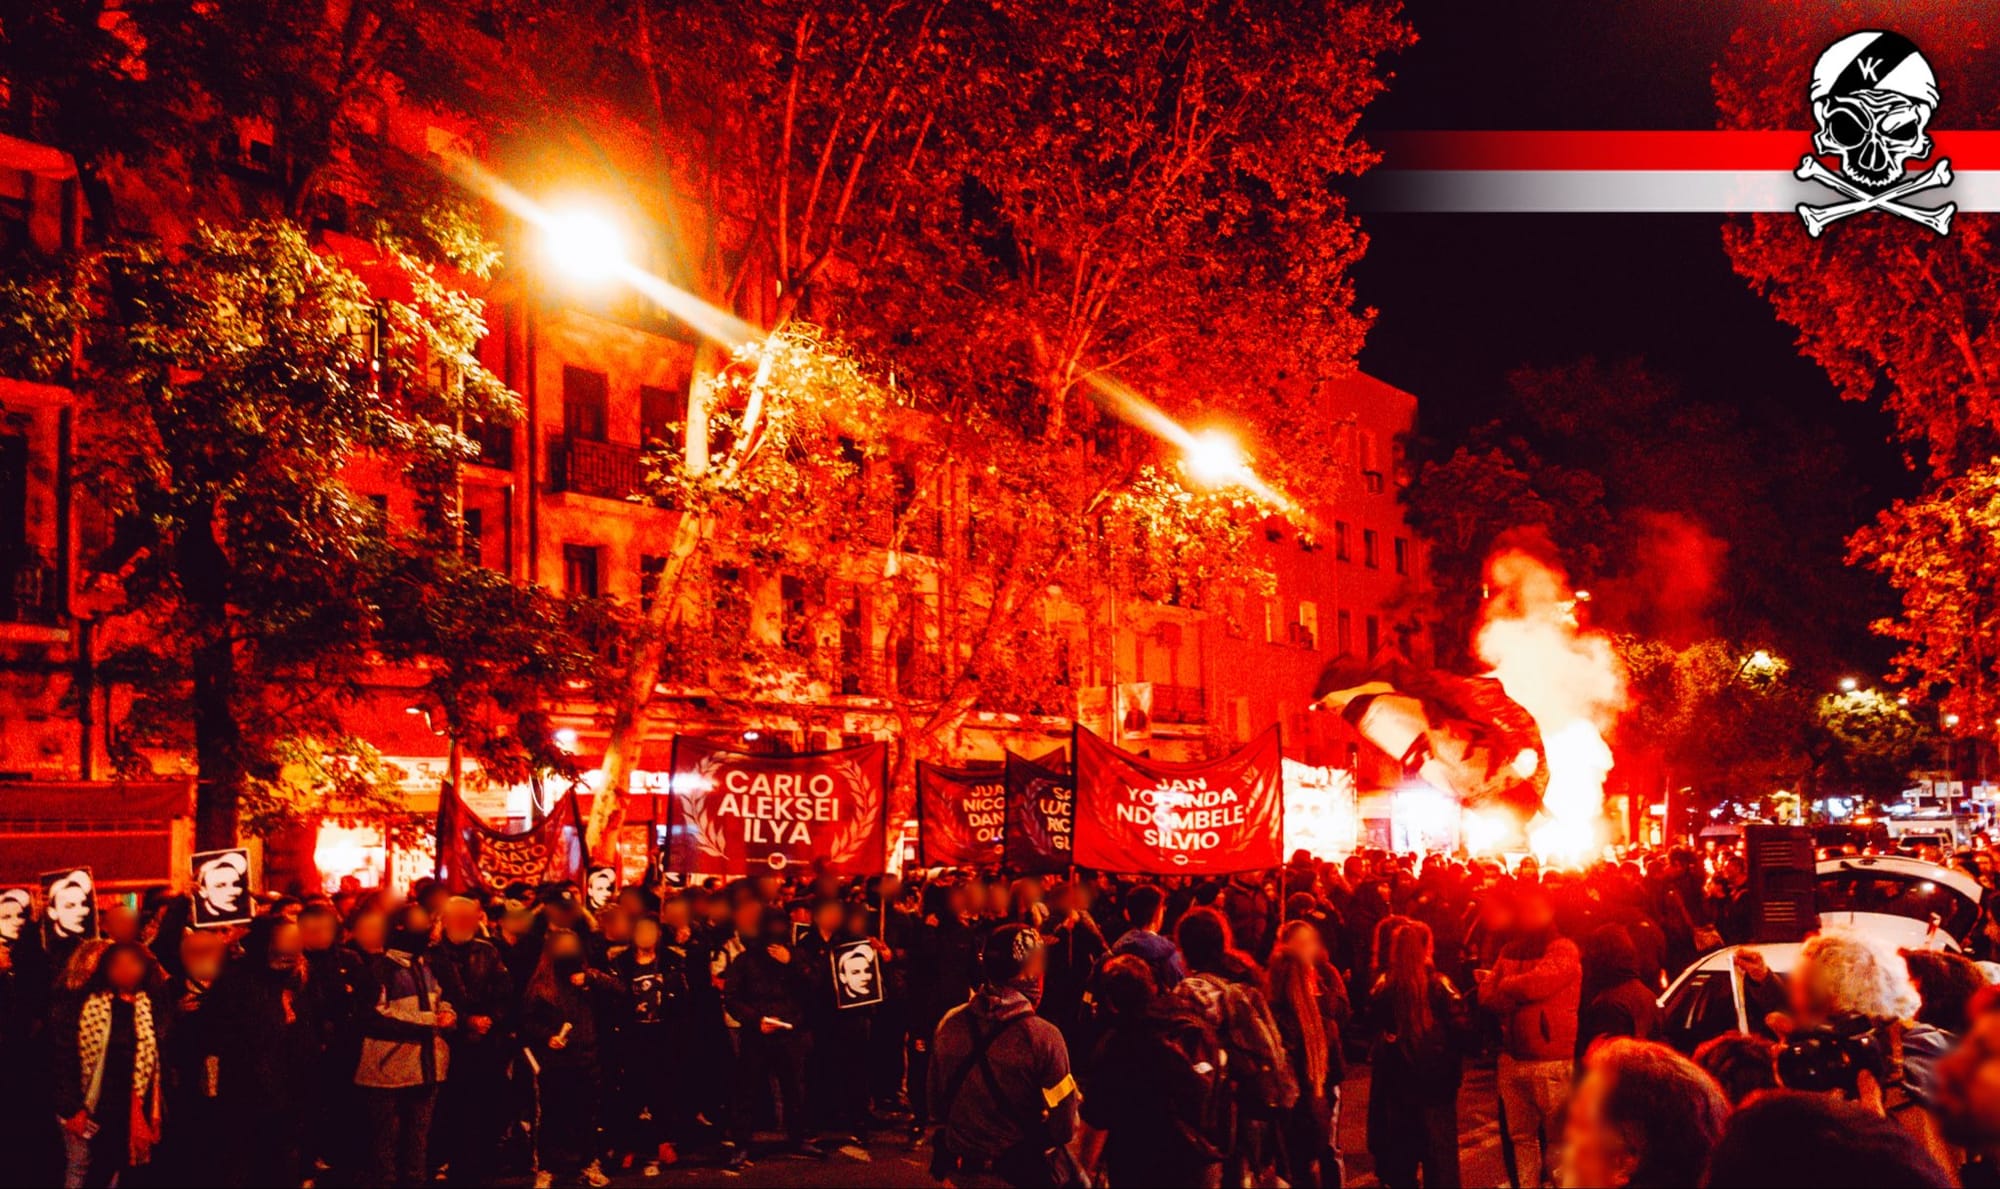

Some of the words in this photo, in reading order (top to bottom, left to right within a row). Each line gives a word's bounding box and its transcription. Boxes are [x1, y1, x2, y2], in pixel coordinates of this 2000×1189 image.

[725, 770, 834, 797] CARLO
[1156, 777, 1207, 791] JAN
[717, 793, 839, 821] ALEKSEI
[1116, 803, 1245, 830] NDOMBELE
[743, 818, 812, 845] ILYA
[1144, 829, 1220, 850] SILVIO
